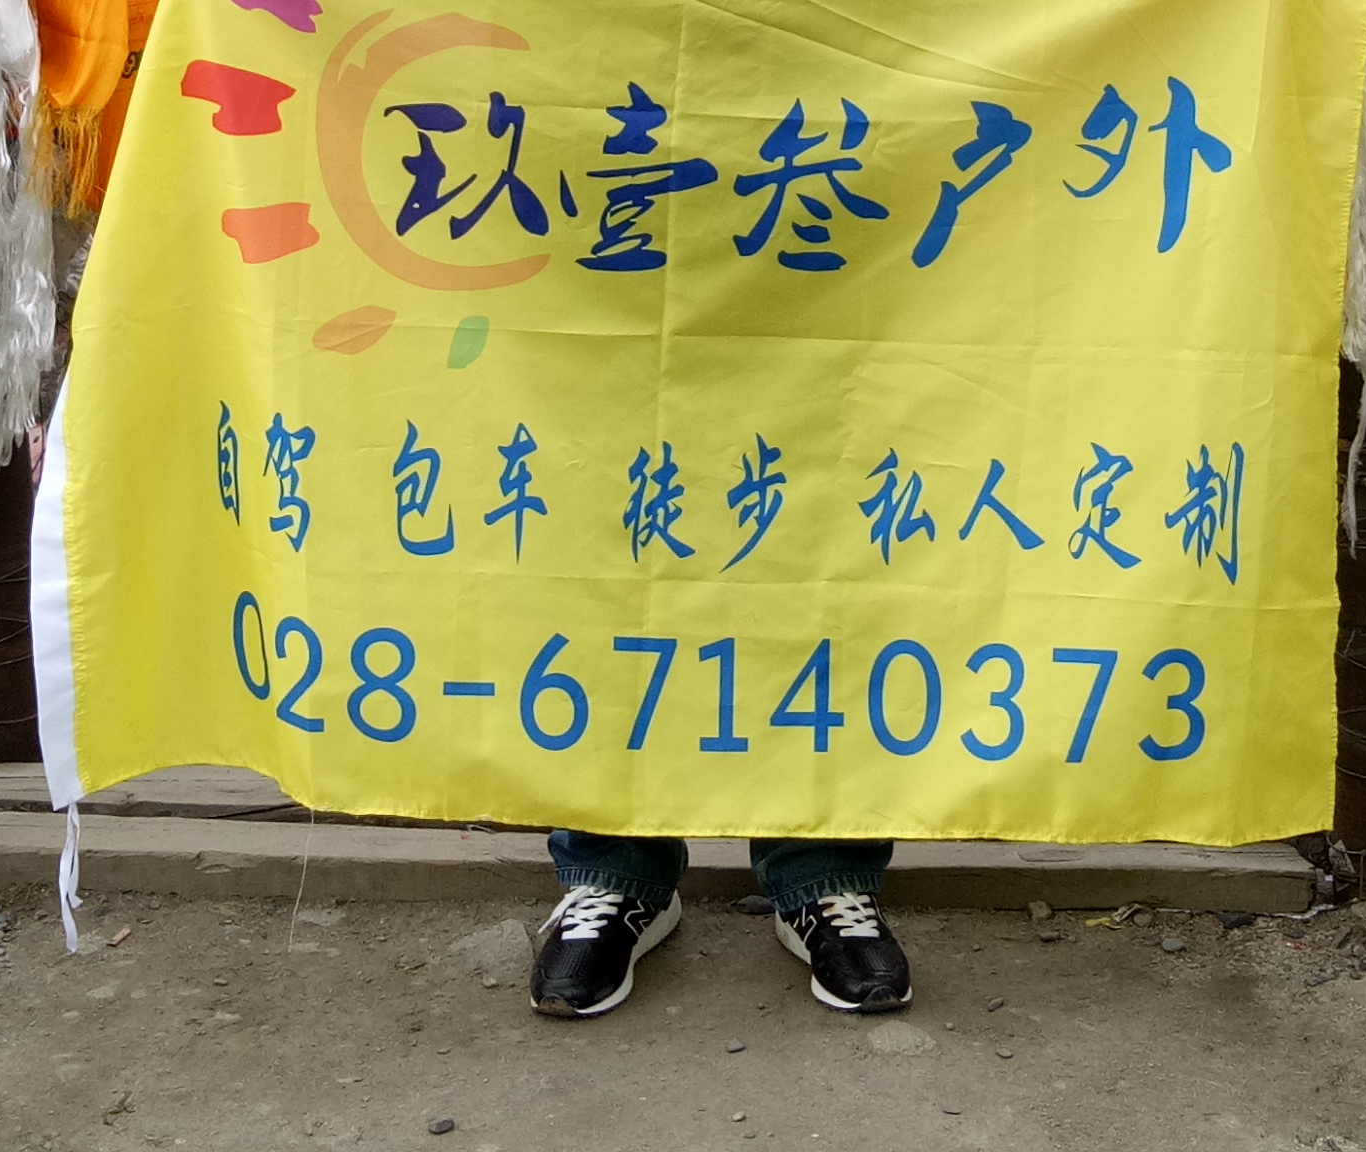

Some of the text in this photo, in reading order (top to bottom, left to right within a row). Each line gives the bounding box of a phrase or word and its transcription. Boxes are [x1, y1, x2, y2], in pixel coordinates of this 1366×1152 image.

[383, 76, 1232, 273] 玖壹叁户外
[216, 402, 1243, 586] 自驾 包车 徒步 私人定制
[233, 591, 1208, 765] 028-67140373
